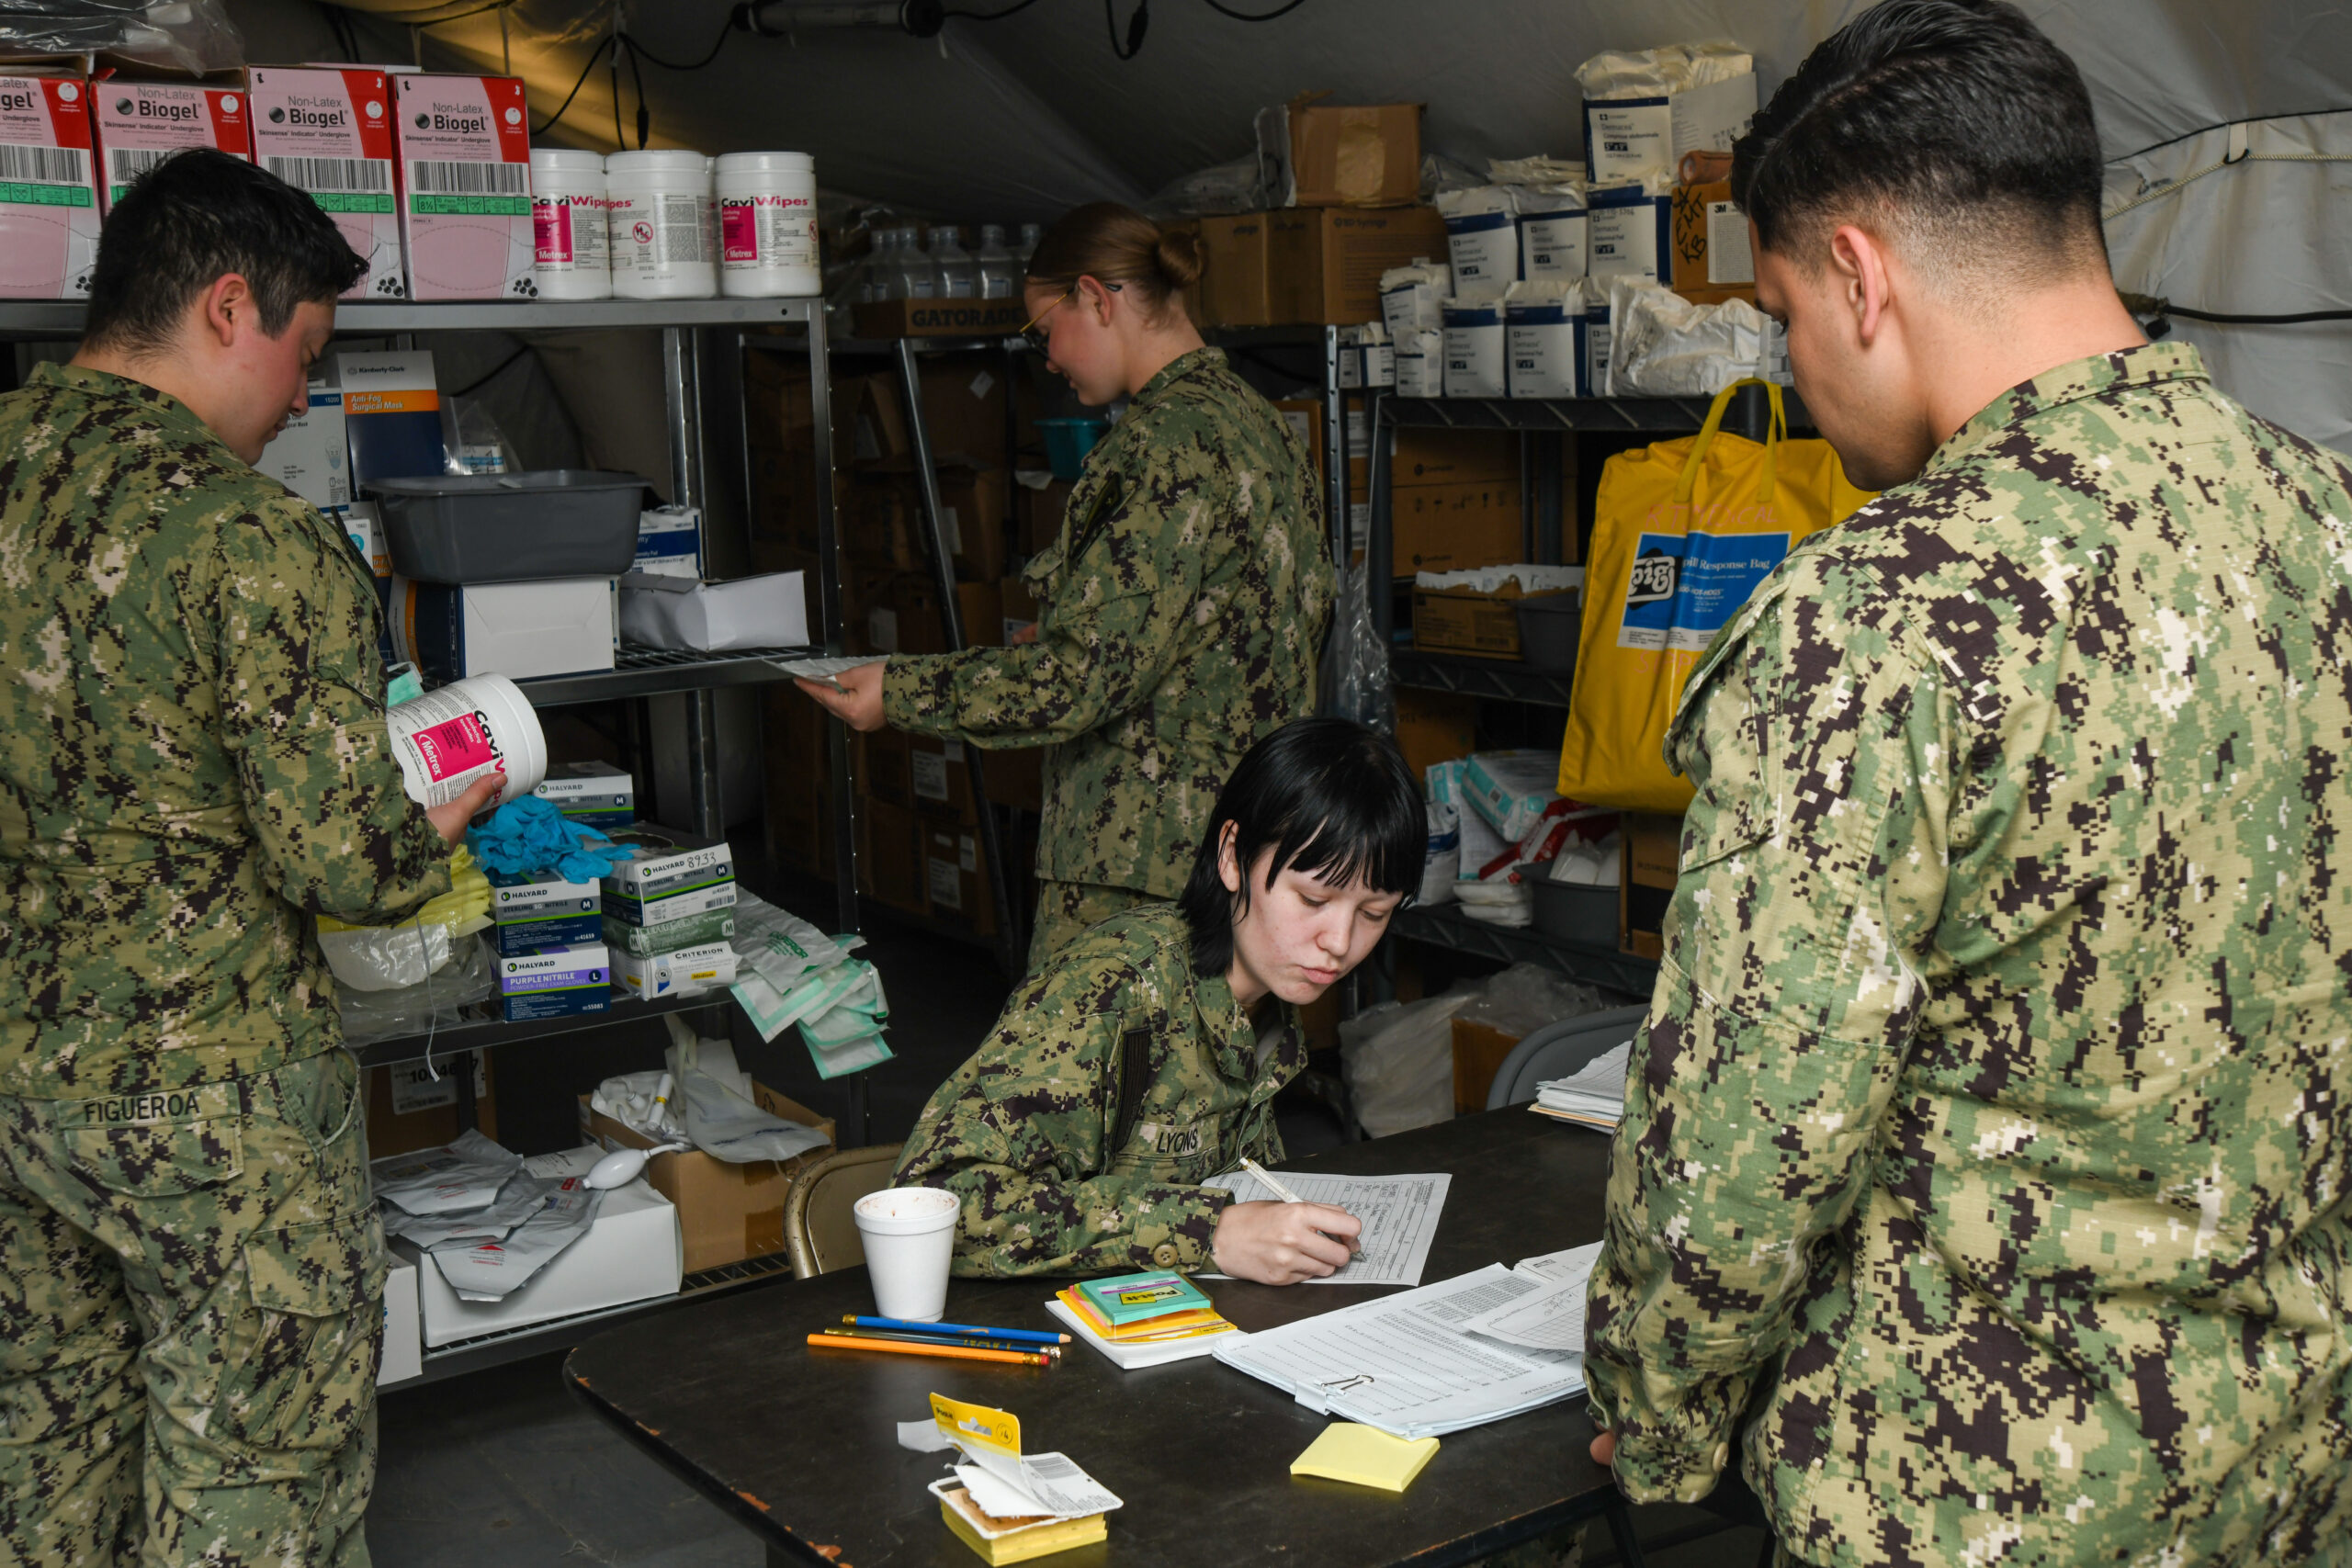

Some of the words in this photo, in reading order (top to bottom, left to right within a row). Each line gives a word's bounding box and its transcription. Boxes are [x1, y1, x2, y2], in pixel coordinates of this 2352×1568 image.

[138, 86, 196, 101] Non-Latex
[1, 91, 34, 110] gel
[288, 96, 342, 107] Non-Latex
[140, 100, 198, 121] Biogel
[433, 102, 483, 114] Non-Latex
[289, 108, 345, 129] Biogel
[434, 114, 487, 134] Biogel
[721, 196, 808, 209] CaviWipes
[1714, 204, 1727, 213] 3M
[538, 251, 568, 259] Metrex
[358, 367, 404, 375] Kimberly-Clark
[351, 395, 382, 403] Anti-Fog
[352, 402, 382, 412] Surgical
[1682, 557, 1698, 569] pill
[1700, 557, 1747, 571] Response
[1750, 558, 1770, 570] Bag
[1629, 558, 1670, 596] pig
[422, 740, 441, 777] Metrex
[687, 852, 717, 868] 8933
[652, 861, 684, 874] HALYARD
[512, 889, 548, 898] HALYARD
[582, 901, 590, 909] M
[726, 923, 733, 933] M
[630, 939, 638, 948] M
[675, 948, 724, 959] CRITERION
[519, 961, 555, 969] HALYARD
[510, 976, 541, 985] PURPLE
[543, 972, 575, 983] NITRILE
[85, 1091, 200, 1122] FIGUEROA
[1156, 1128, 1198, 1154] LYONS
[1126, 1290, 1177, 1302] Post-it
